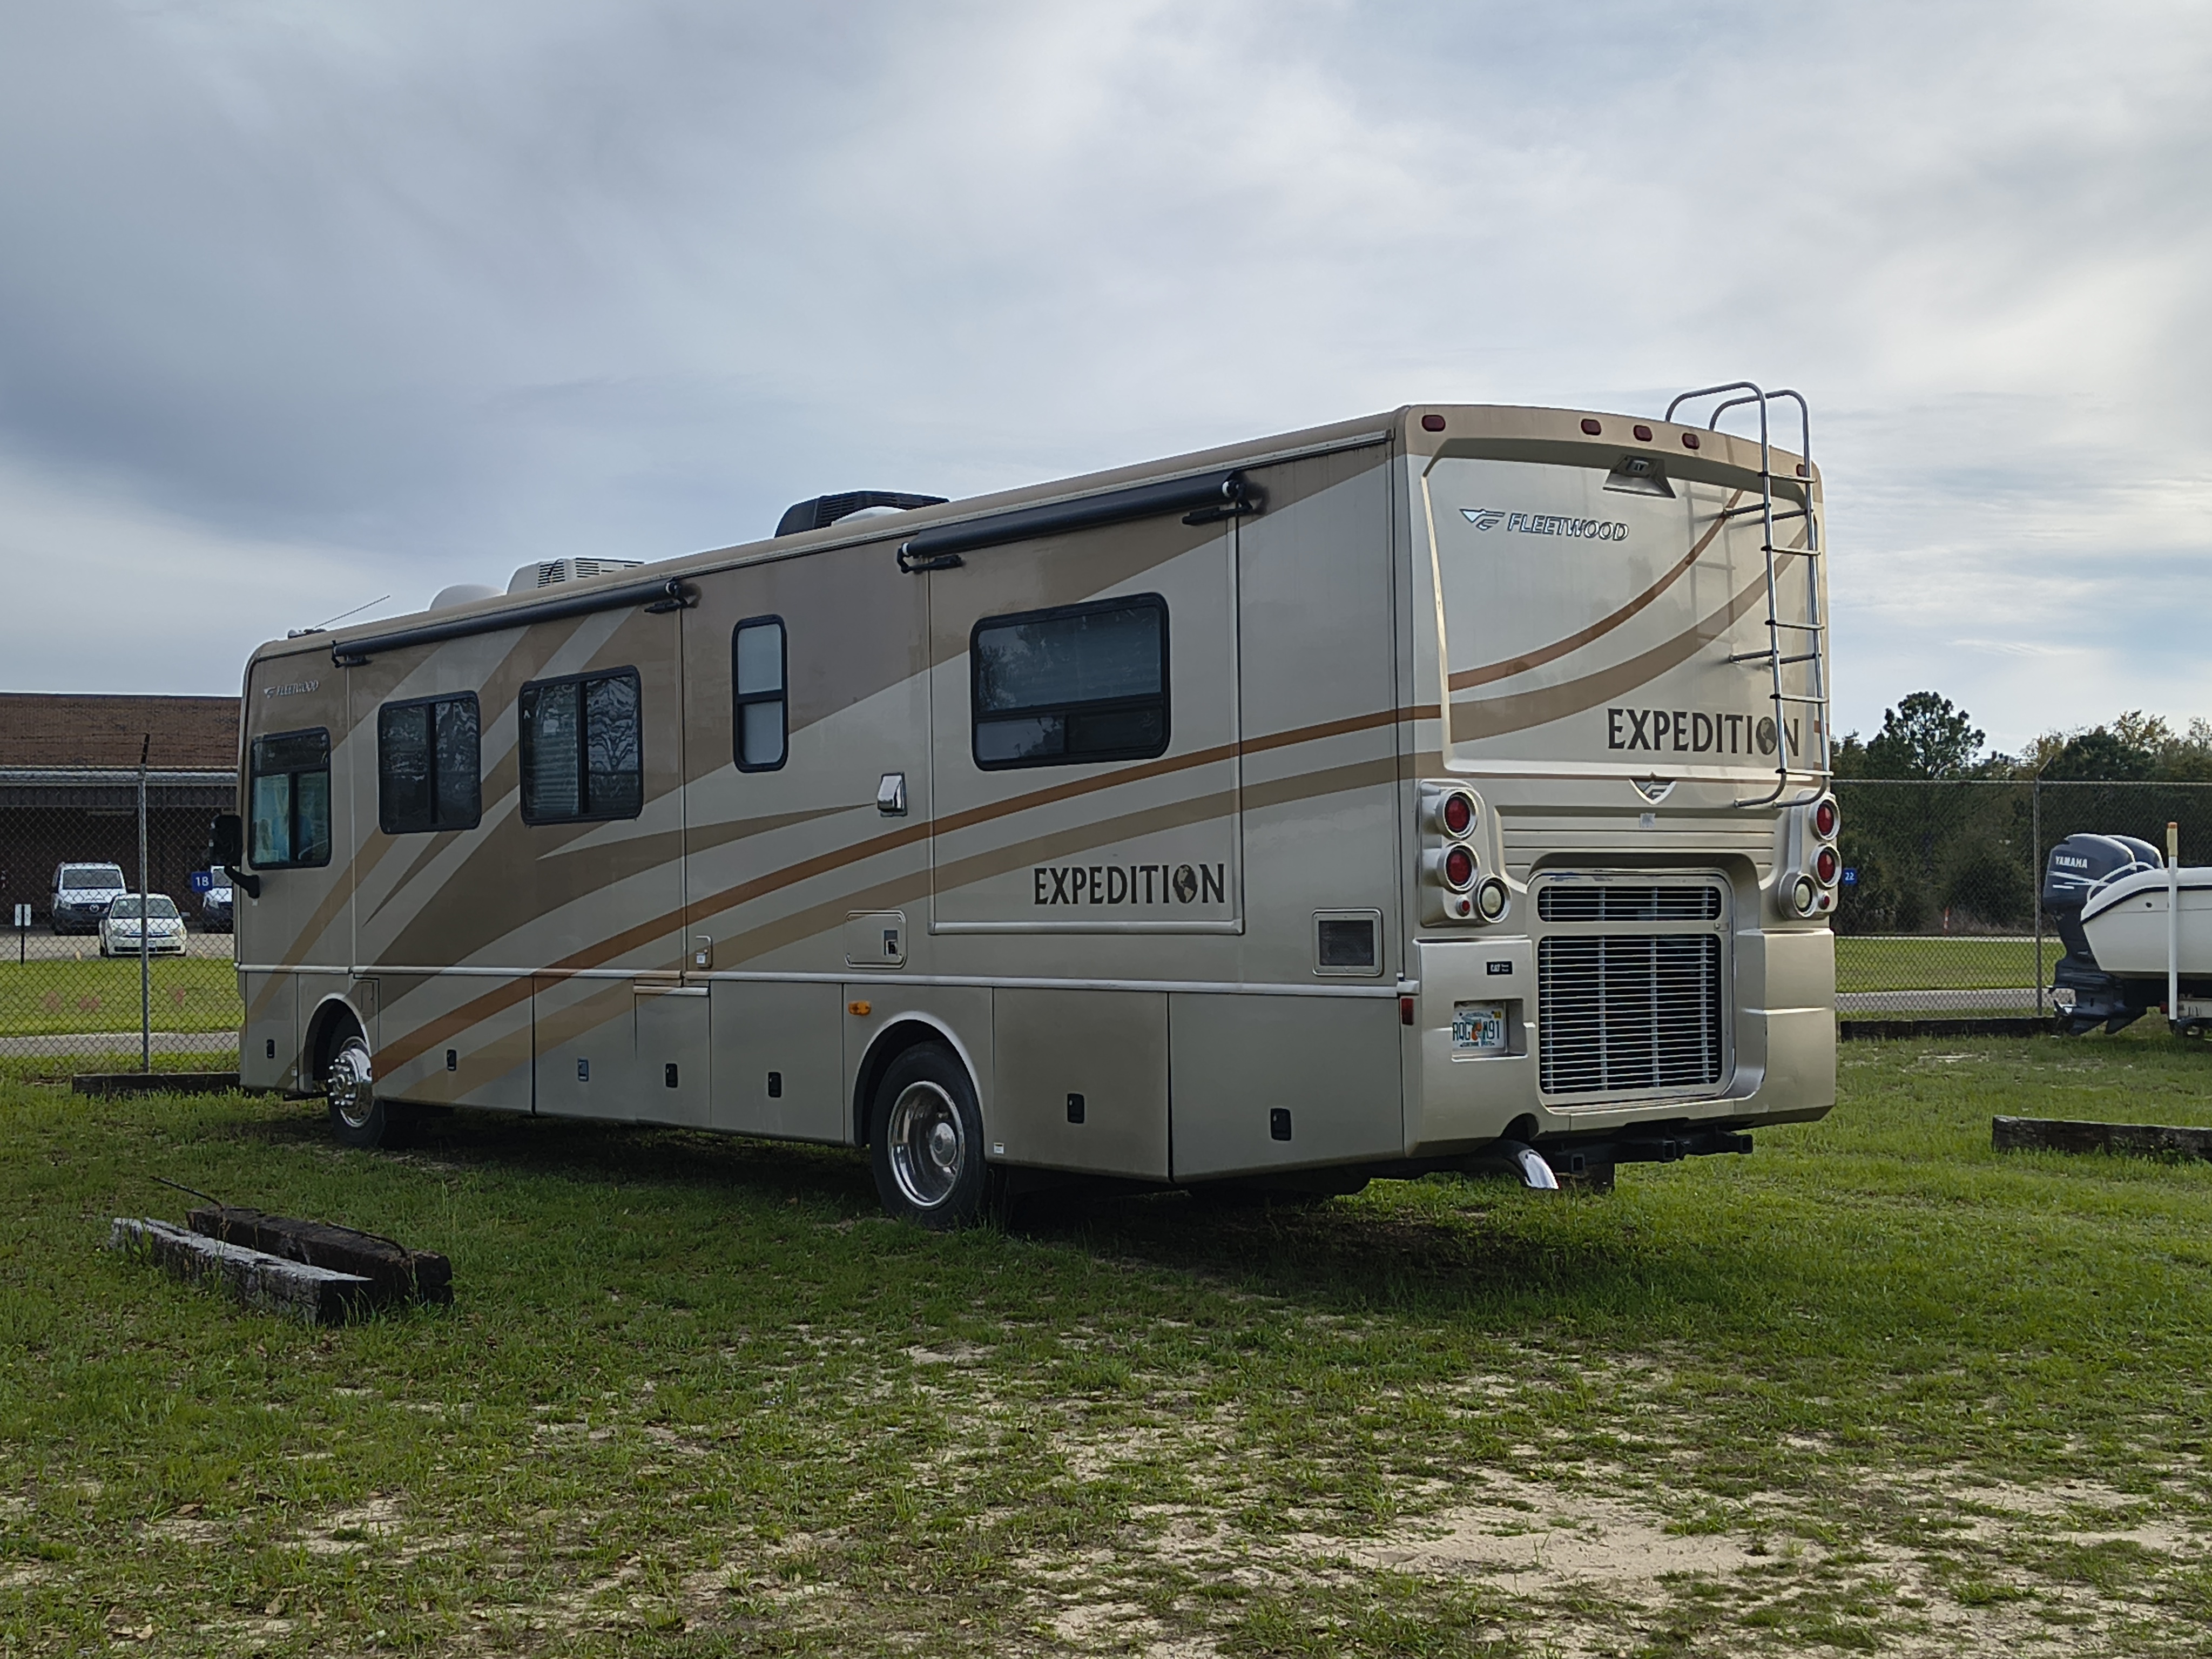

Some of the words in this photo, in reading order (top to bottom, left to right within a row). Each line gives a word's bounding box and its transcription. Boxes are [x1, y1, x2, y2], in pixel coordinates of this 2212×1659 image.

[1507, 512, 1629, 541] FLEETWOOD
[1607, 708, 1799, 757] EXPEDITION
[2055, 855, 2088, 868] YAMAHA
[195, 876, 209, 887] 18
[1034, 863, 1225, 905] EXPEDITION
[1845, 872, 1855, 881] 22
